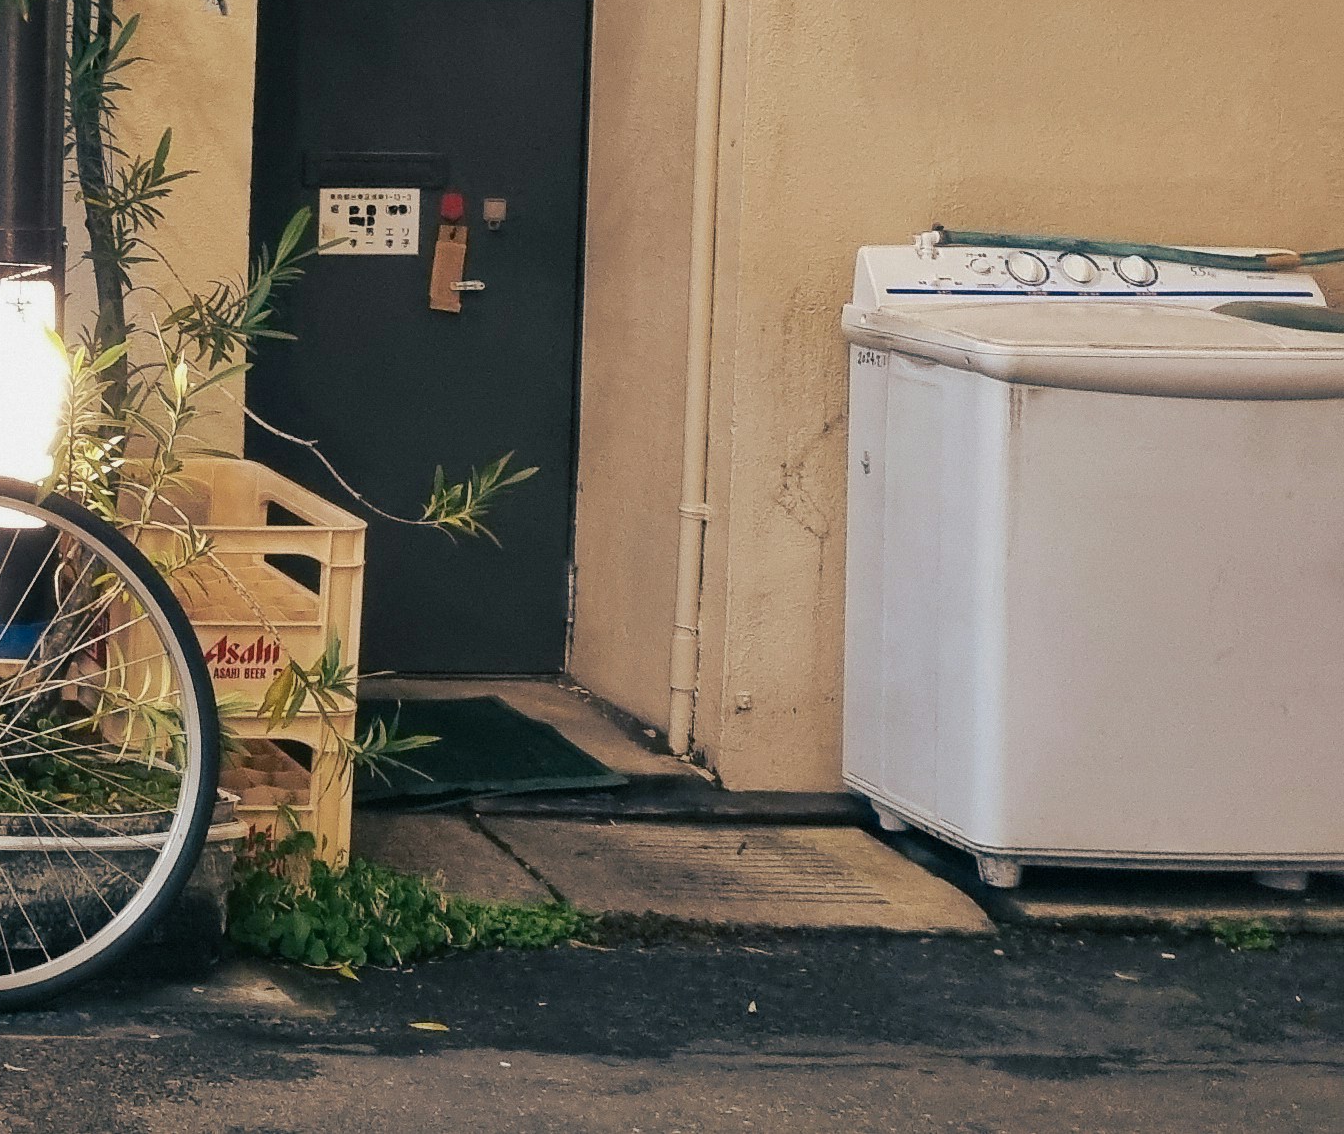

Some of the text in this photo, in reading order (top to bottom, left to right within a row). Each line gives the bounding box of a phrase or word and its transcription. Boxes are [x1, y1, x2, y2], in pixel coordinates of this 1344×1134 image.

[204, 635, 281, 665] Asahi
[213, 667, 240, 679] ASAHI
[244, 667, 266, 679] BEER
